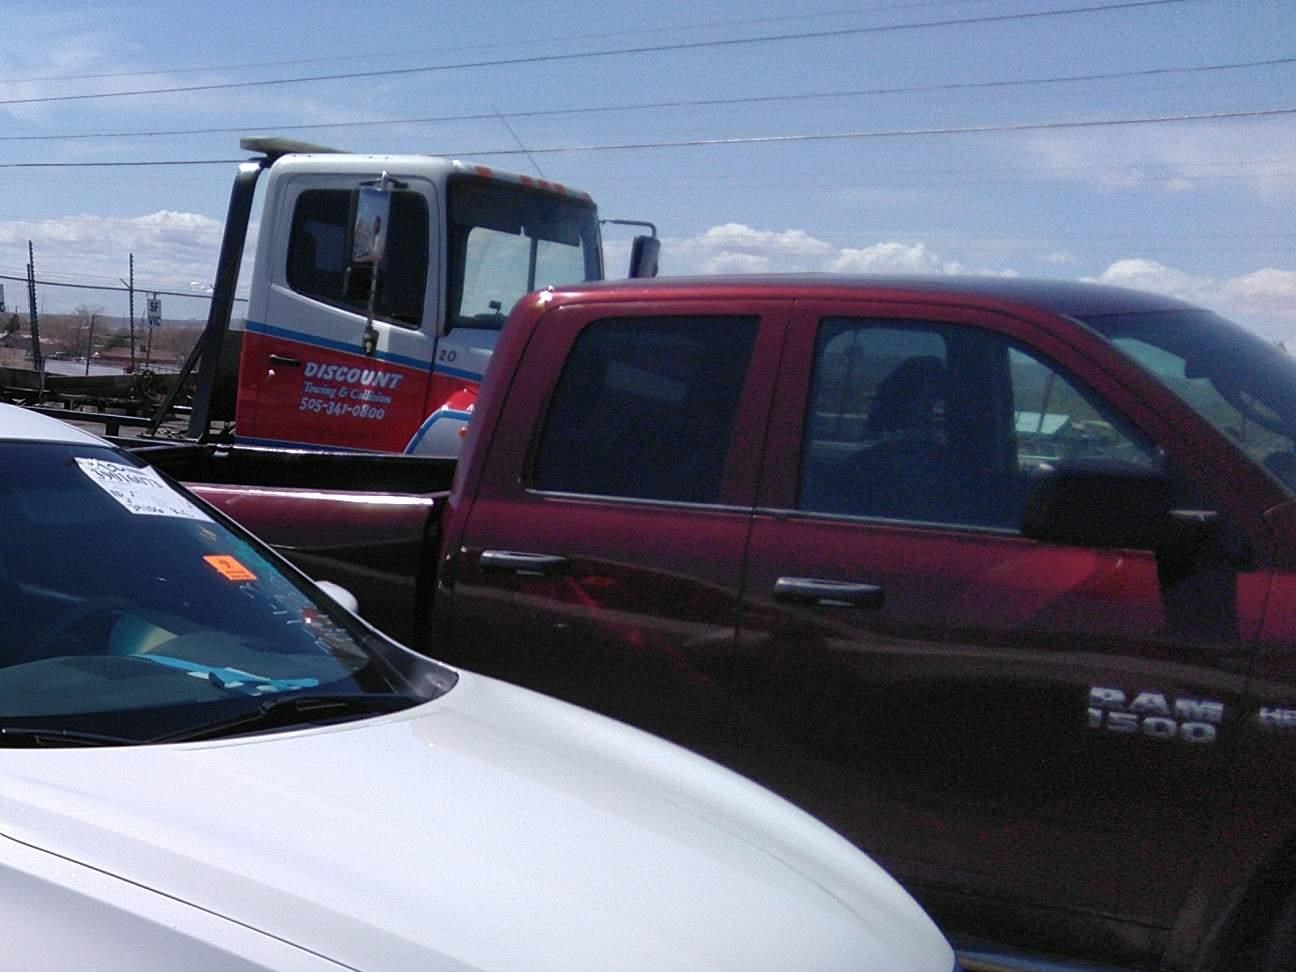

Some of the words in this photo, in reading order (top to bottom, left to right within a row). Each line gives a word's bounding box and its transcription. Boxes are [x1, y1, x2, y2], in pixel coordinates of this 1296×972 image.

[149, 301, 159, 312] SF
[438, 349, 457, 362] 20
[304, 361, 402, 390] DISCOUNT
[338, 386, 347, 398] &
[299, 397, 385, 420] 505-341-0800
[1088, 686, 1224, 722] RAM
[1087, 707, 1217, 743] 1500
